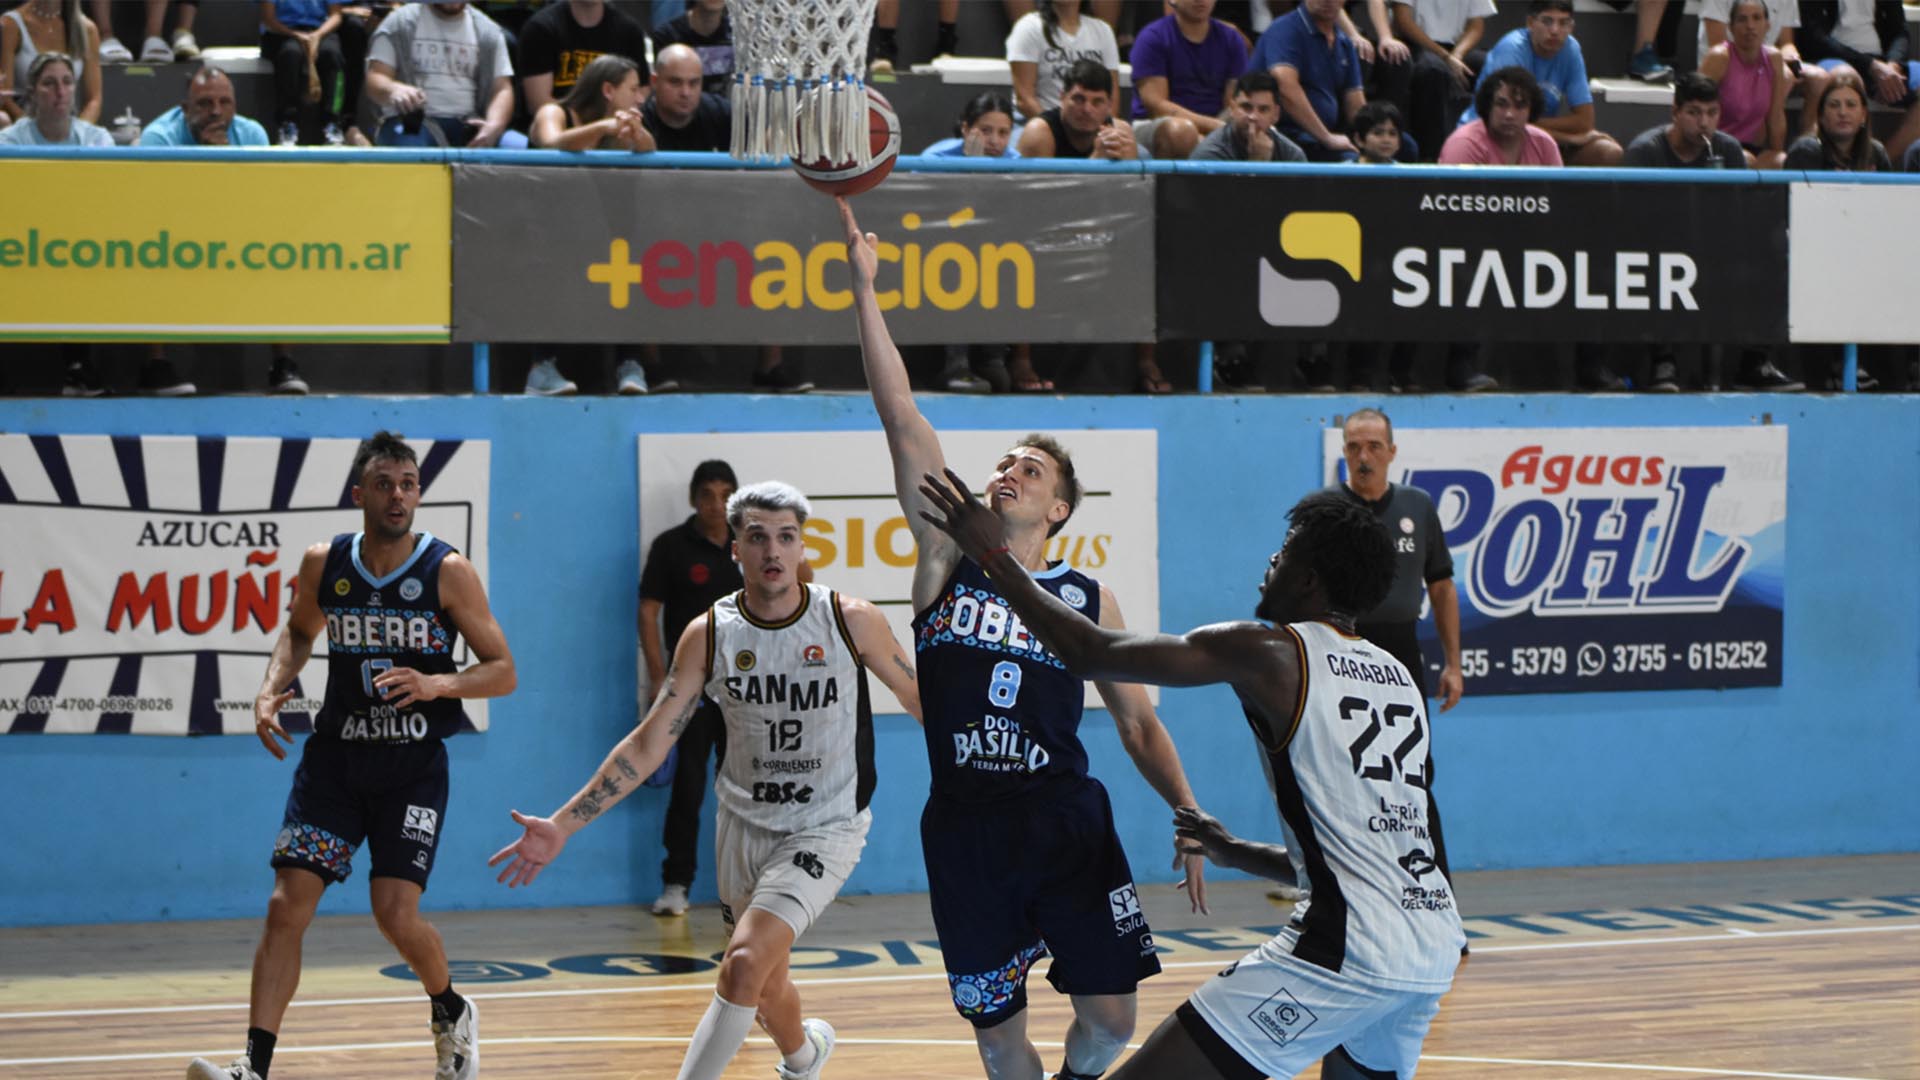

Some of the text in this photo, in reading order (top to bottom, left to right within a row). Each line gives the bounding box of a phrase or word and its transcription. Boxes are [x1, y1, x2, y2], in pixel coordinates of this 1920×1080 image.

[1420, 194, 1551, 214] ACCESORIOS
[0, 229, 411, 271] elcondor.com.ar
[1392, 247, 1700, 311] STADLER
[1502, 445, 1665, 494] Aguas
[136, 521, 281, 548] AZUCAR
[1402, 465, 1752, 616] POHL
[106, 549, 299, 636] MUÑ
[1511, 647, 1567, 676] 5379
[1612, 643, 1667, 673] 3755
[1688, 641, 1768, 671] 615252
[360, 658, 394, 698] 17
[988, 660, 1023, 709] 8
[341, 712, 428, 741] BASILIO
[370, 704, 398, 719] DON
[984, 714, 1021, 733] DON
[765, 719, 803, 752] 18
[953, 729, 1050, 771] BASILIO
[1338, 695, 1426, 789] 22
[763, 758, 822, 770] CORRIENTES
[401, 828, 434, 848] Salud
[1111, 888, 1140, 918] SP
[1115, 915, 1146, 937] Salu
[1258, 1011, 1289, 1041] CORSOL
